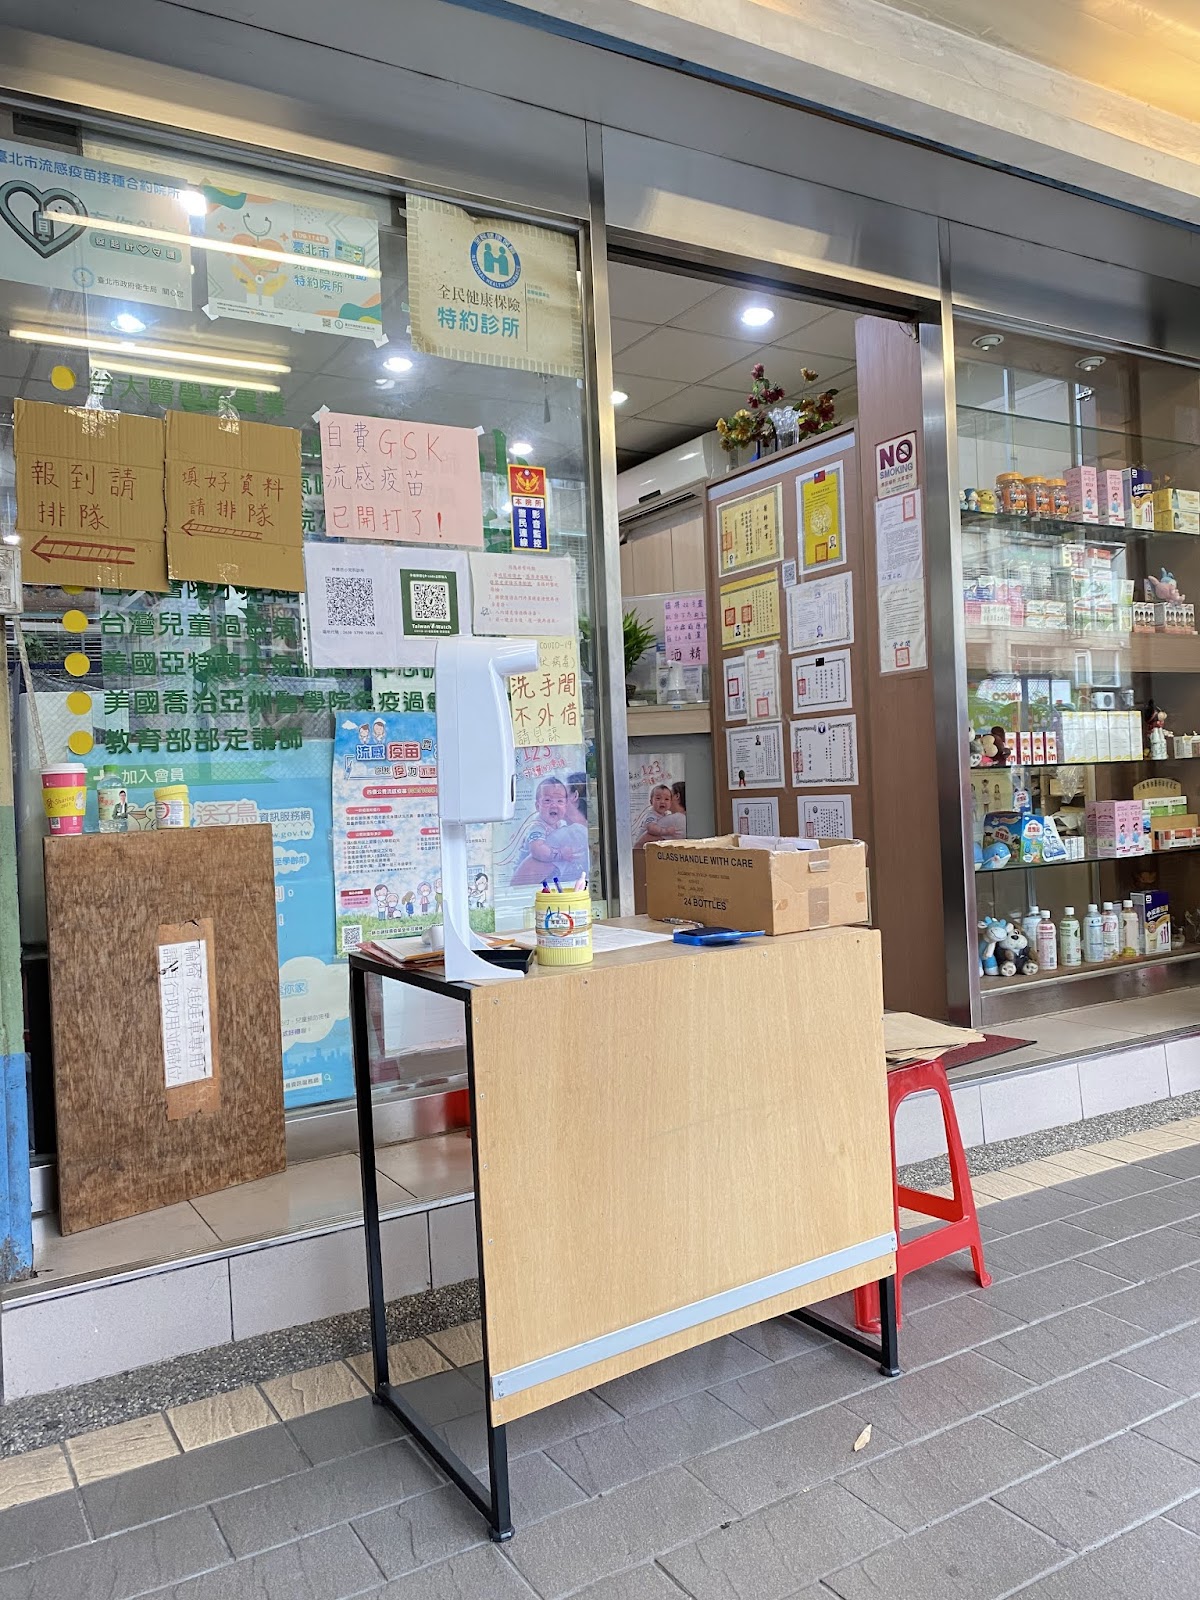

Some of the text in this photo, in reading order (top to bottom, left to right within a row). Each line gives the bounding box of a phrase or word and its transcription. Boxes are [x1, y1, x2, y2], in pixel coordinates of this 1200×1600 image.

[293, 240, 329, 258] 臺北市
[294, 274, 343, 294] 特約院所
[438, 283, 521, 313] 全民健康保險
[437, 306, 520, 339] 特約診所
[879, 439, 913, 471] NO
[31, 460, 137, 501] 報到請
[325, 462, 424, 498] 流感疫苗
[879, 462, 913, 480] SMOKING
[181, 470, 284, 502] 填好資料
[38, 501, 110, 530] 排隊
[189, 499, 275, 528] 請排隊
[515, 498, 541, 507] 本院所
[531, 509, 542, 548] 影音監控
[511, 672, 576, 699] 洗手間
[514, 702, 577, 727] 不外借
[104, 727, 304, 755] 教育部部定講師
[356, 743, 420, 760] 流感疫苗
[121, 767, 185, 785] 加入會員
[196, 802, 311, 826] 送子鳥 資訊服務網
[656, 851, 753, 868] GLASS HANDLE WITH CARE
[683, 897, 727, 911] 24 BOTTLES
